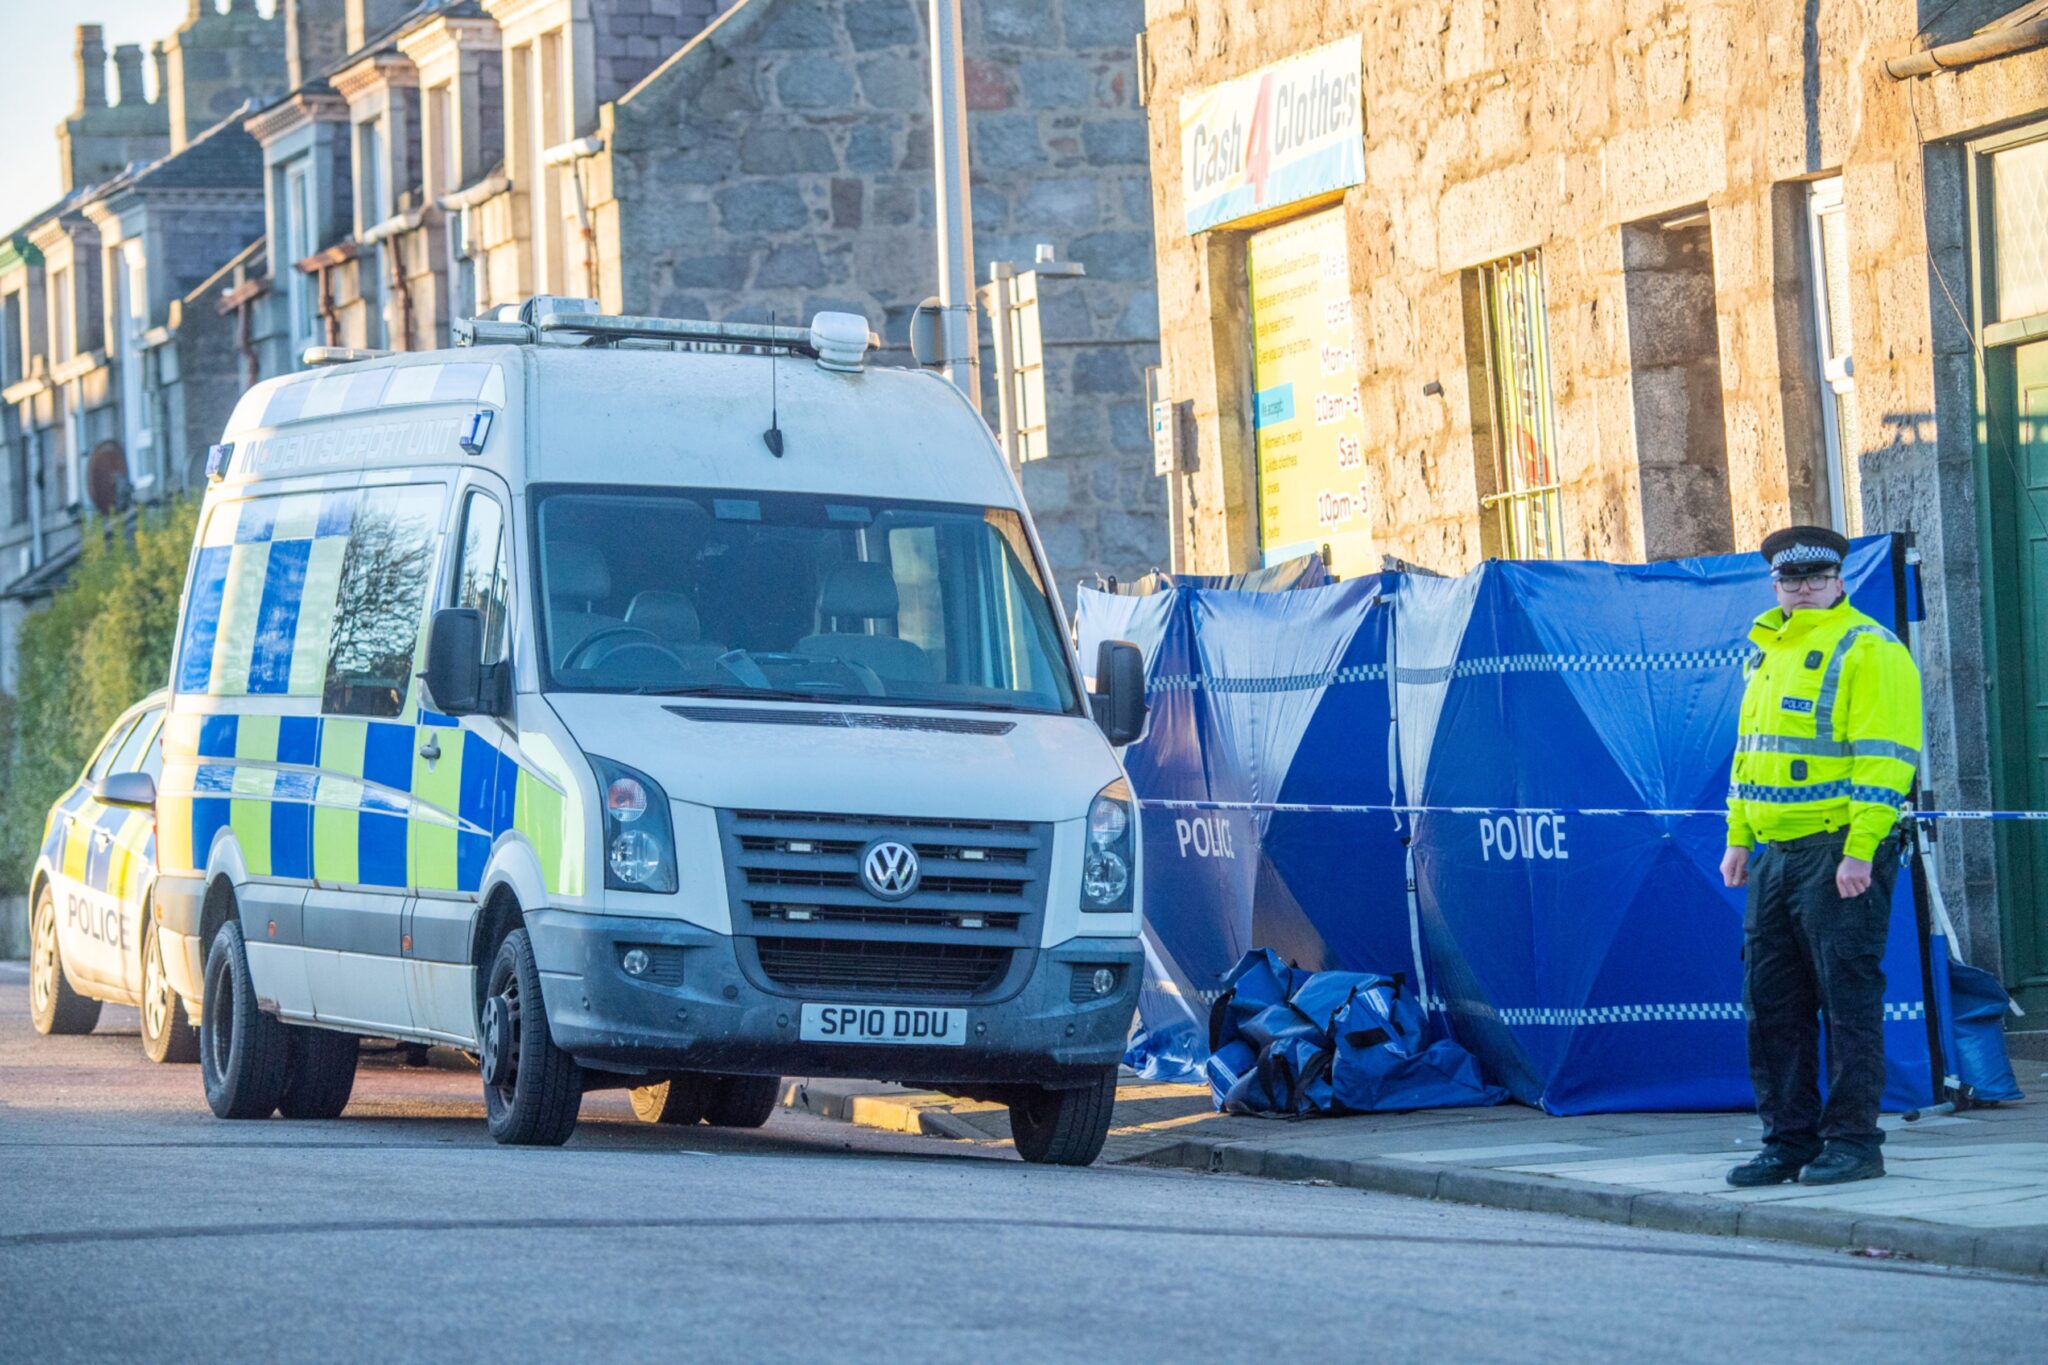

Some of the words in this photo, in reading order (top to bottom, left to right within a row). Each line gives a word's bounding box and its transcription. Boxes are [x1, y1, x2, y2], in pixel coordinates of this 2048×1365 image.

[1193, 110, 1241, 192] Cash
[1245, 72, 1274, 205] 4
[1275, 69, 1356, 156] Clothes
[1316, 395, 1344, 422] 10am
[240, 431, 323, 474] INCIDENT
[318, 421, 410, 465] SUPPORT
[407, 418, 460, 456] UNIT
[1339, 436, 1360, 466] Sat
[1319, 492, 1351, 526] 10pm
[1783, 698, 1812, 711] POLICE
[1480, 815, 1569, 861] POLICE
[68, 892, 131, 952] POLICE
[820, 1008, 885, 1036] SP10
[893, 1010, 948, 1038] DDU
